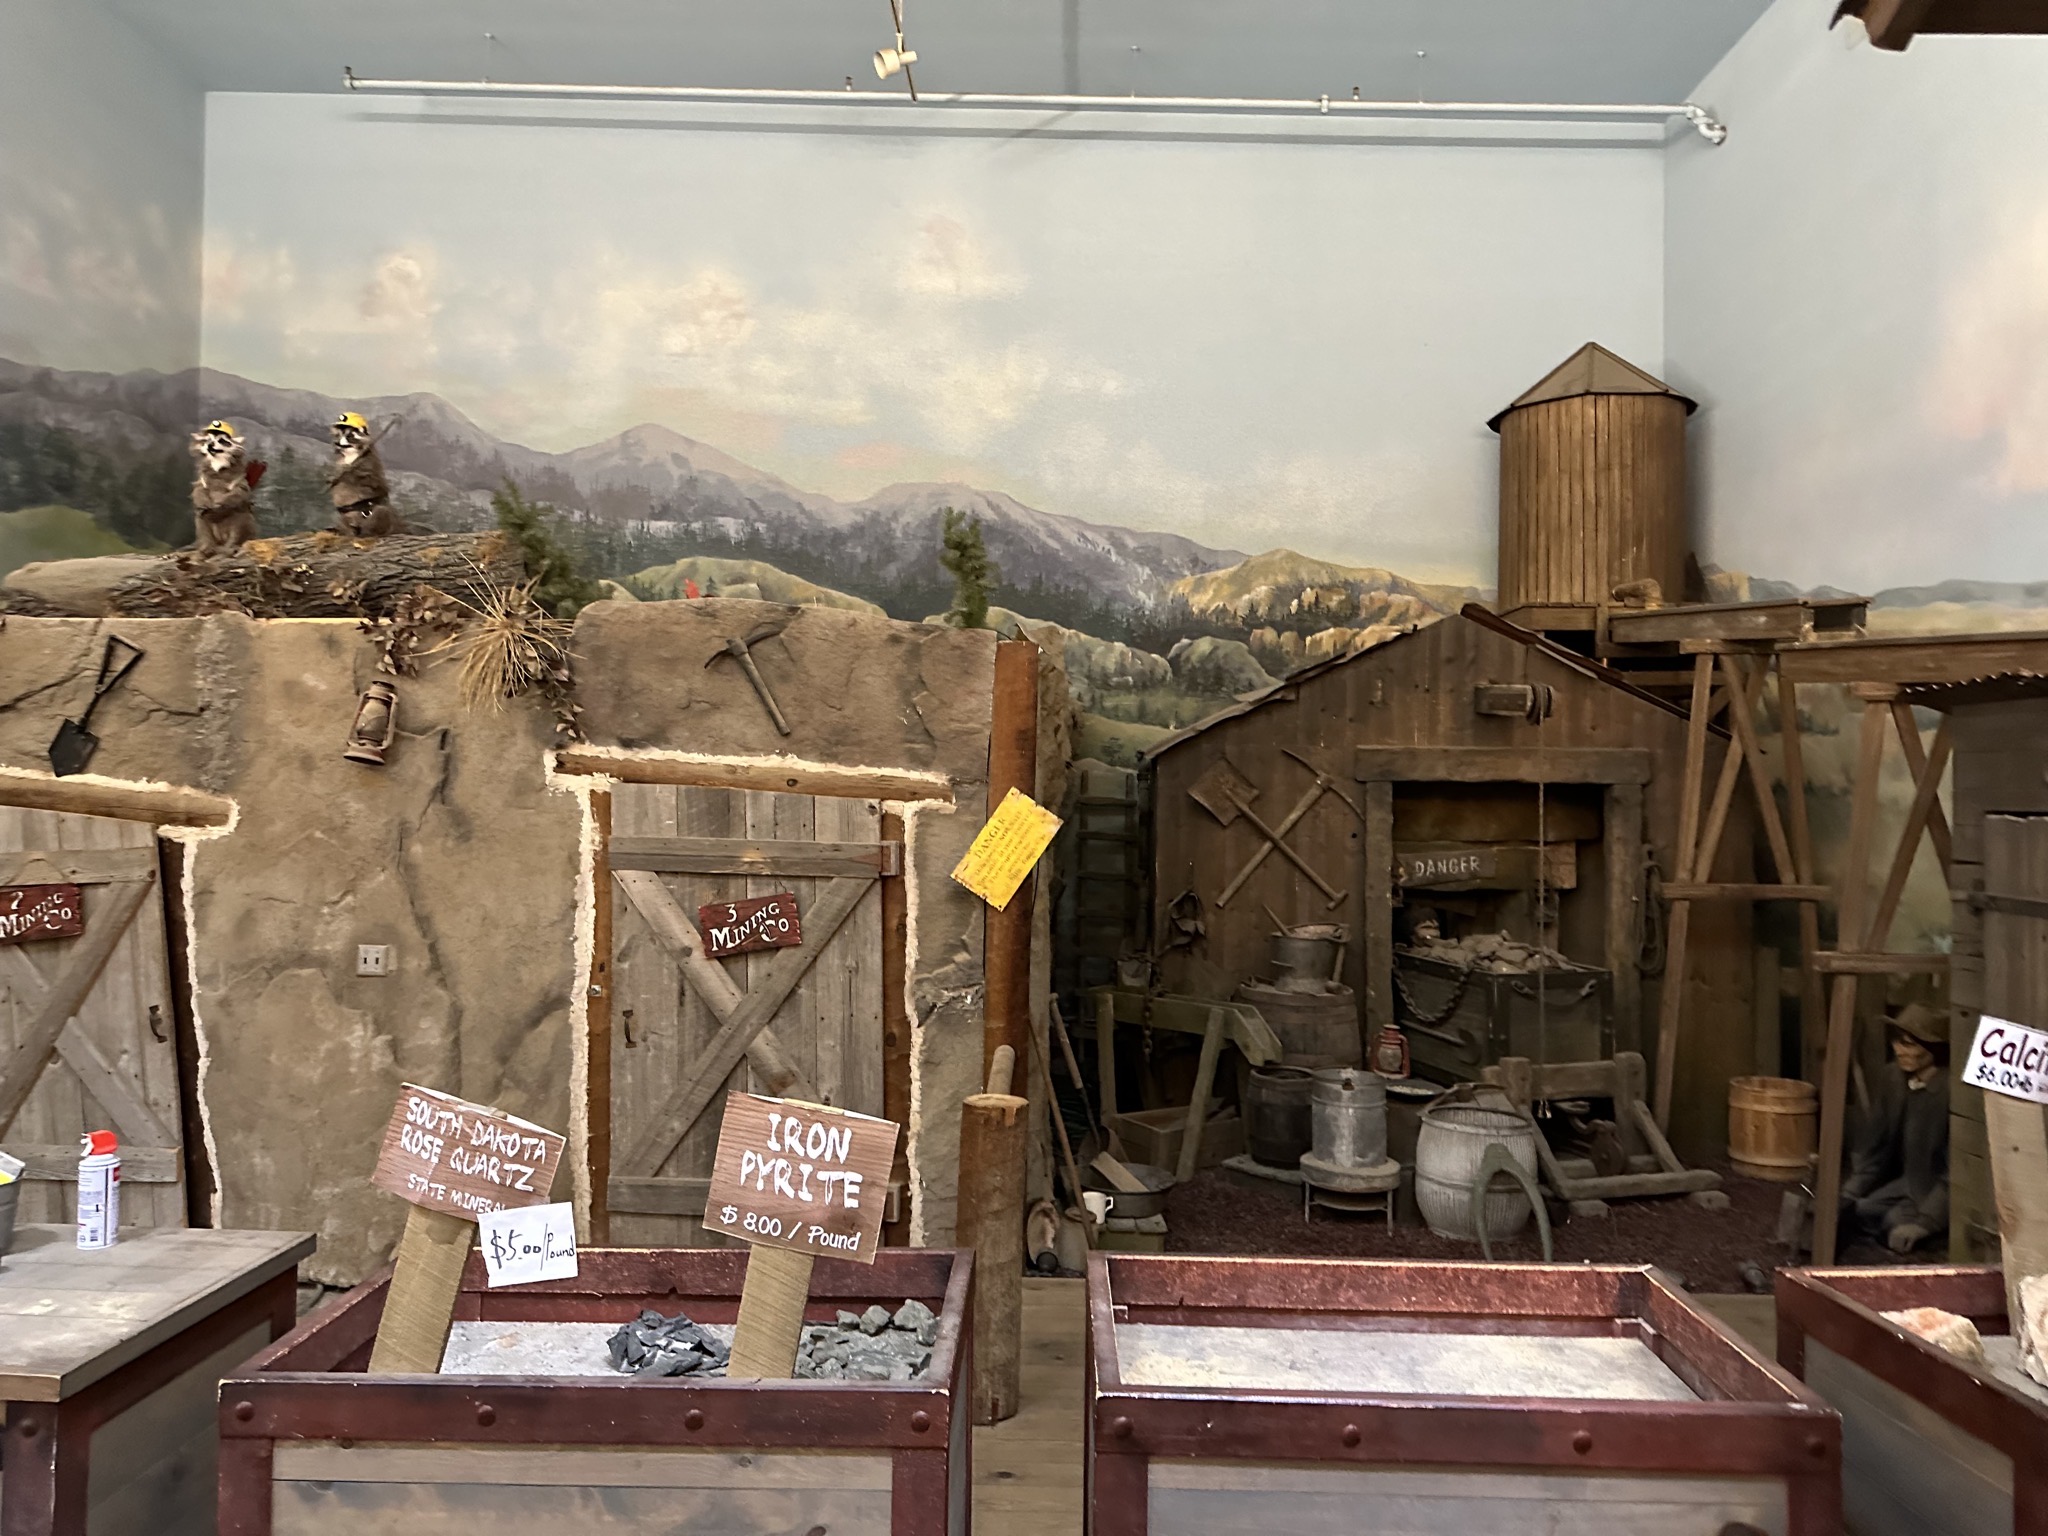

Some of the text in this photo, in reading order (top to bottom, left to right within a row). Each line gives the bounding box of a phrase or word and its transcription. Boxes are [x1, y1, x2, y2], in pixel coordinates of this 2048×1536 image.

[1415, 856, 1480, 877] DANGER
[709, 903, 780, 951] MINING
[724, 904, 738, 922] 3
[1981, 1028, 2048, 1076] Calci
[406, 1097, 546, 1164] SOUTH DAKOTA
[767, 1113, 852, 1164] IRON
[400, 1124, 536, 1192] ROSE QUARTZ
[740, 1150, 863, 1208] PYRITE
[407, 1173, 446, 1200] STATE
[808, 1225, 861, 1251] Pound
